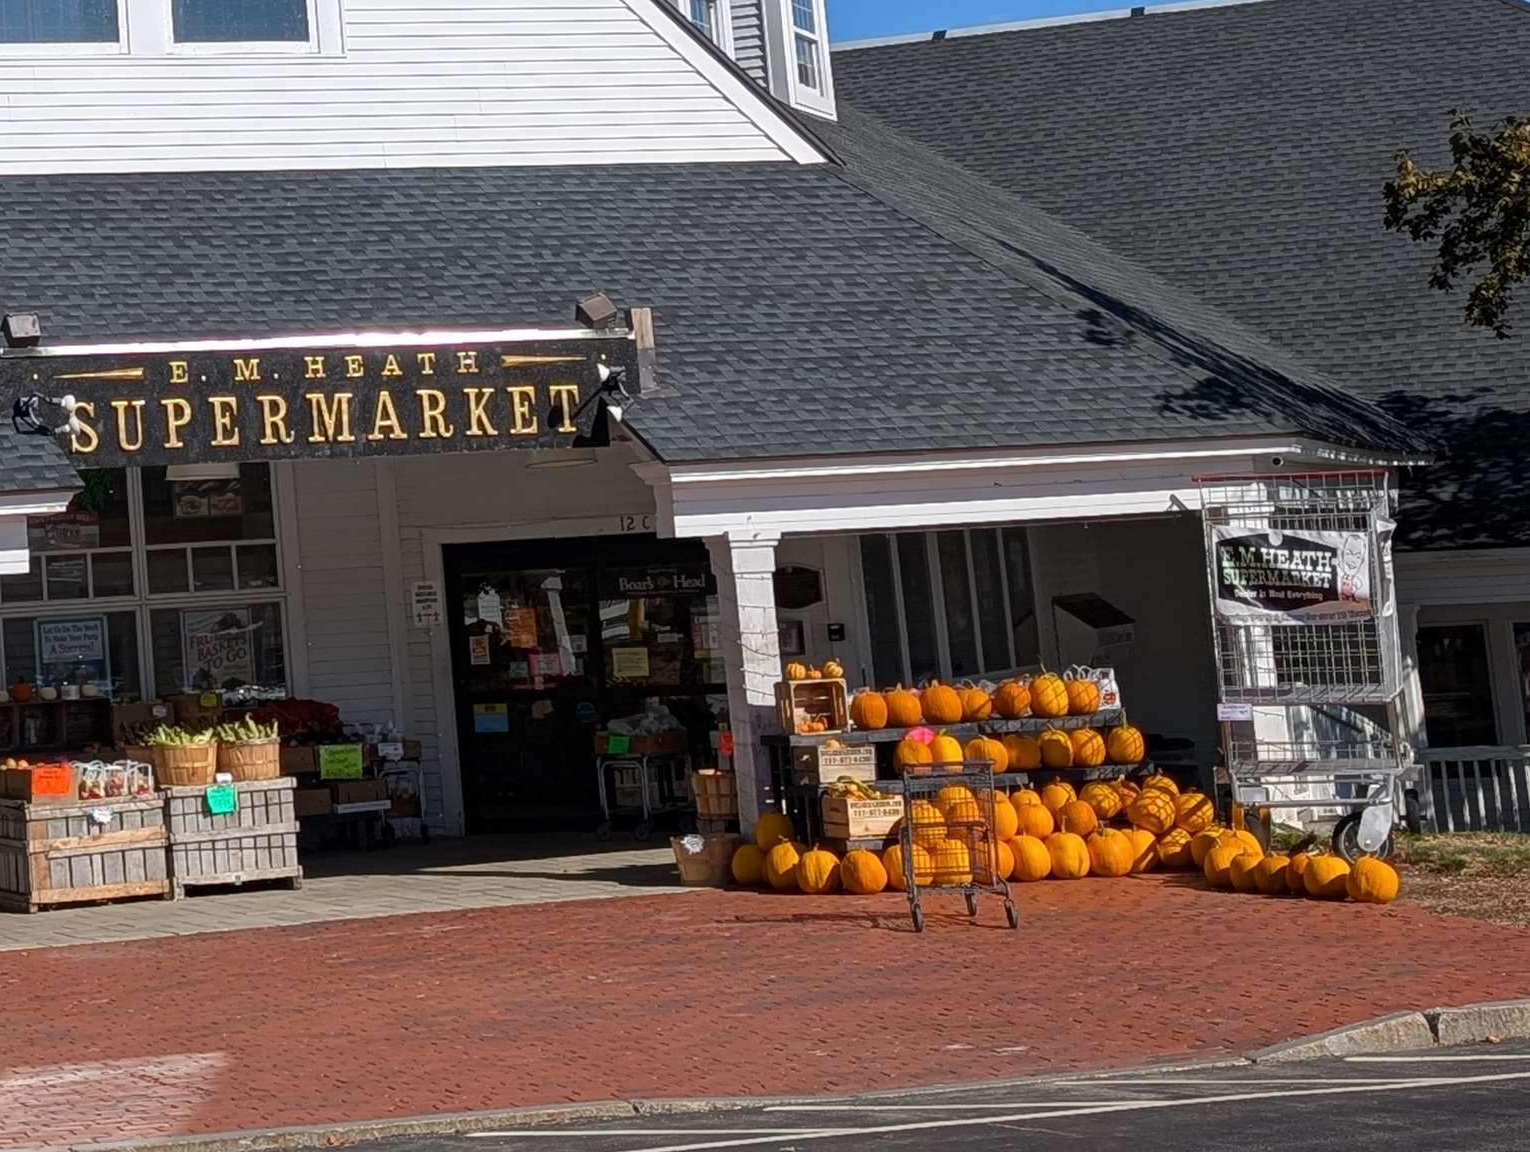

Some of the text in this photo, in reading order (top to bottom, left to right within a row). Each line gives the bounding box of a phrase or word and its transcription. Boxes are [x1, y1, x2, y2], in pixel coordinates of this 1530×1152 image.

[304, 351, 480, 379] HEATH
[70, 384, 580, 453] SUPERMARKET
[620, 516, 635, 531] 12
[674, 574, 706, 588] Head
[1222, 569, 1331, 588] SUPERMARKET
[198, 637, 247, 660] BASKETS
[205, 647, 247, 672] TO GO
